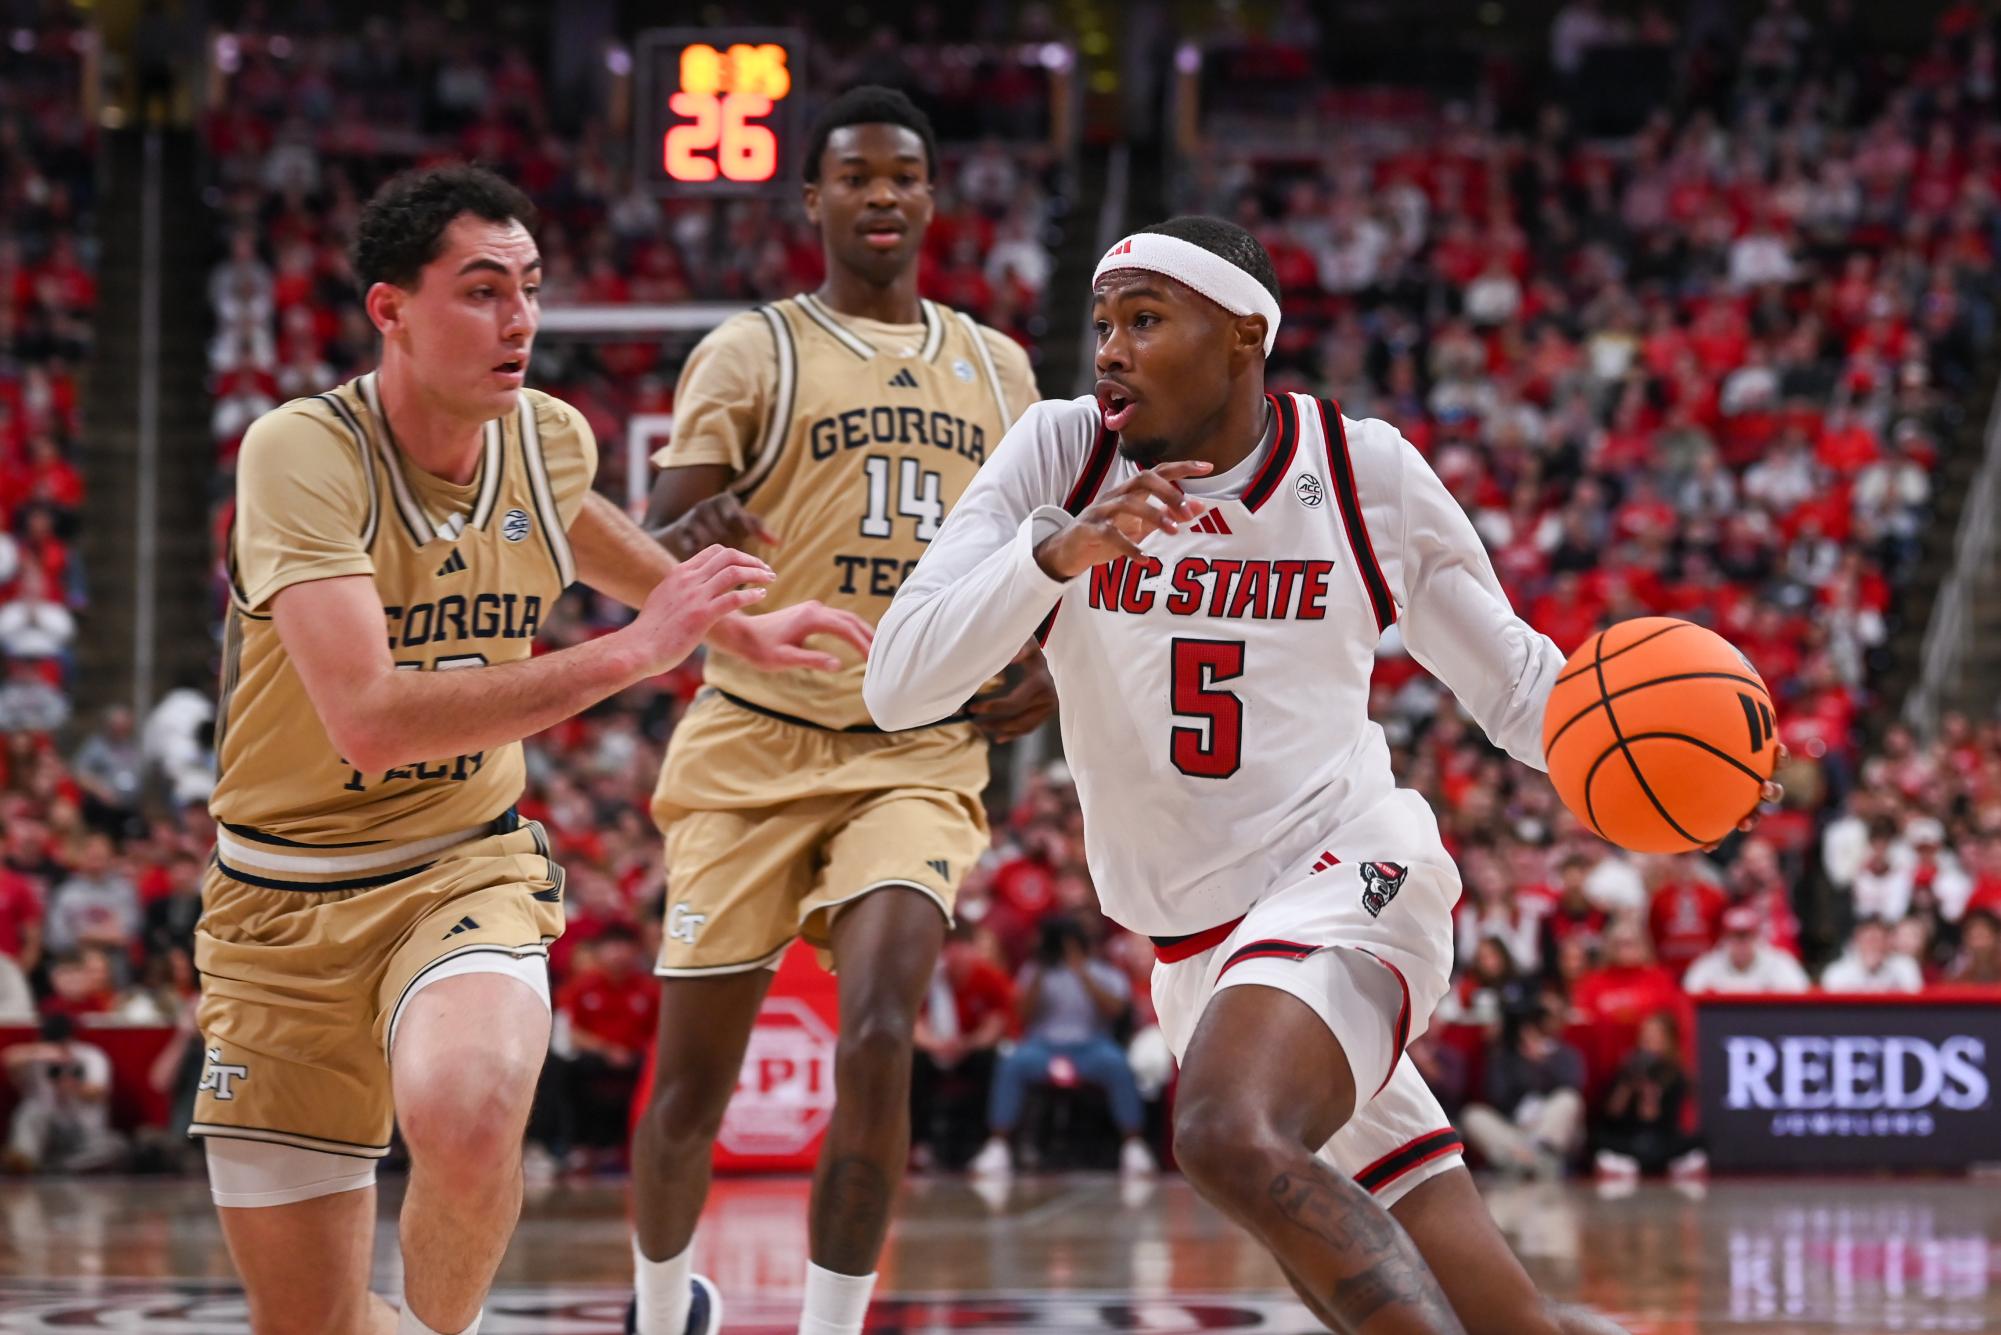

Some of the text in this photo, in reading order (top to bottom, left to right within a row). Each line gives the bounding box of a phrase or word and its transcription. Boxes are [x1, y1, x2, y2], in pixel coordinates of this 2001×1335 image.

[664, 93, 777, 181] 26
[811, 406, 985, 467] GEORGIA
[860, 454, 944, 542] 14
[1299, 483, 1320, 494] ACC
[834, 554, 919, 597] TE
[1089, 555, 1336, 620] NC STATE
[384, 593, 541, 650] EORGIA
[1170, 637, 1246, 780] 5
[735, 1057, 822, 1094] PI
[1725, 1034, 1989, 1111] REEDS
